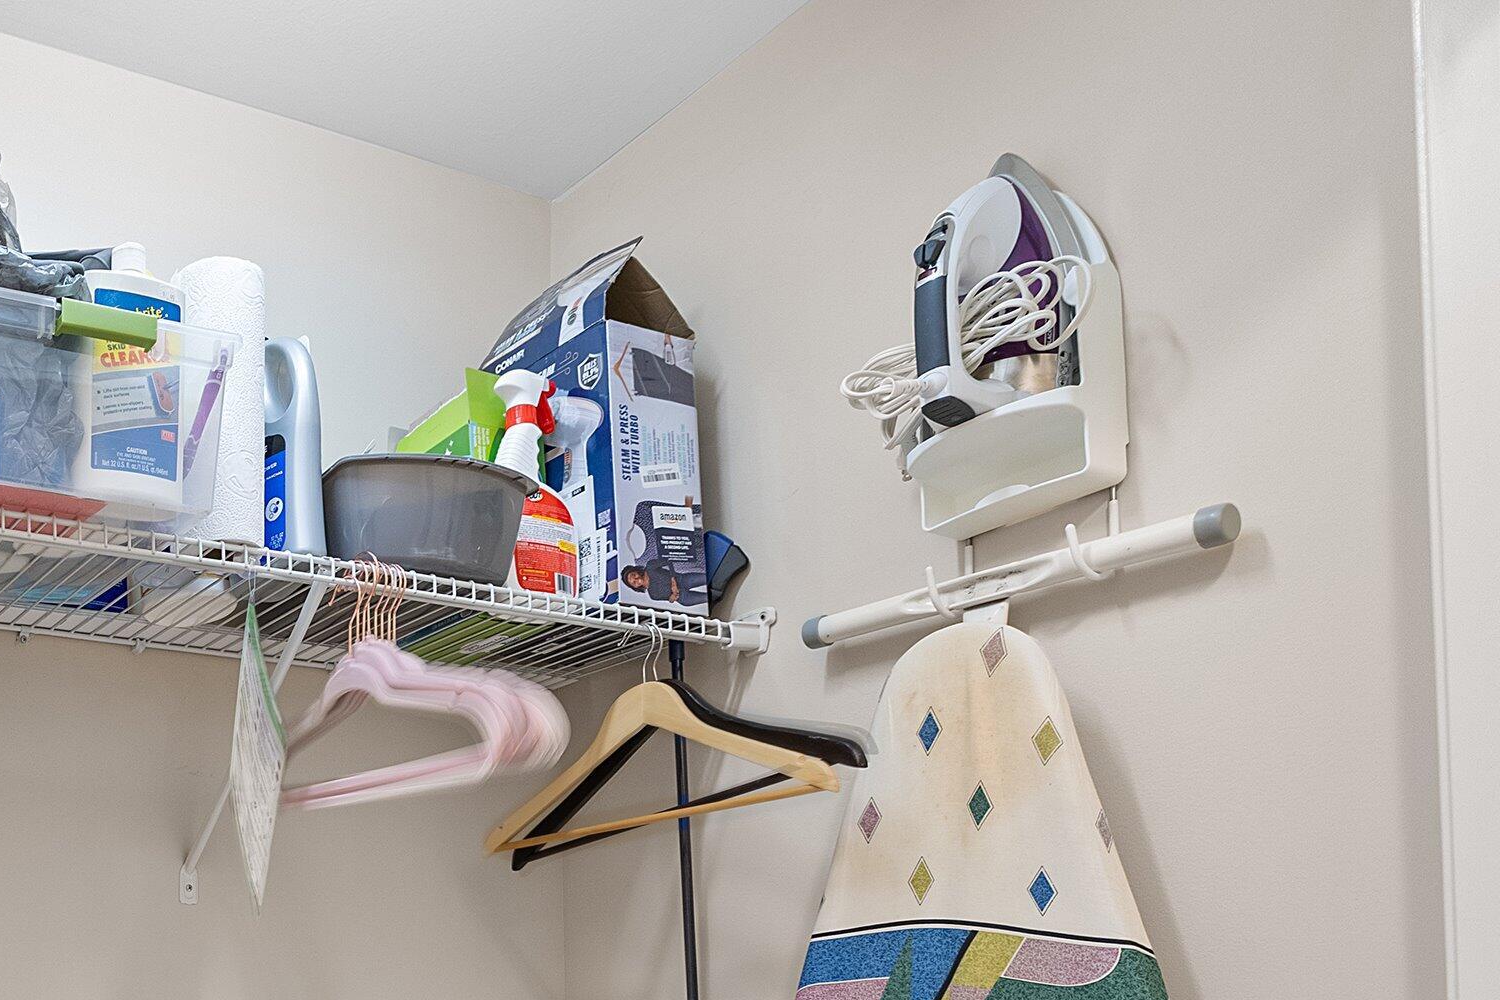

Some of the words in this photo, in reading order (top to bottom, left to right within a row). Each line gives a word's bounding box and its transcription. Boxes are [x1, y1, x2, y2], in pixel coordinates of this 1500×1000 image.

[495, 348, 525, 374] CONAIR
[619, 404, 629, 434] PRESS
[630, 414, 639, 445] TURBO
[126, 446, 148, 455] CAUTION
[630, 449, 640, 474] WITH
[621, 449, 631, 481] STEAM
[660, 513, 687, 521] amazon
